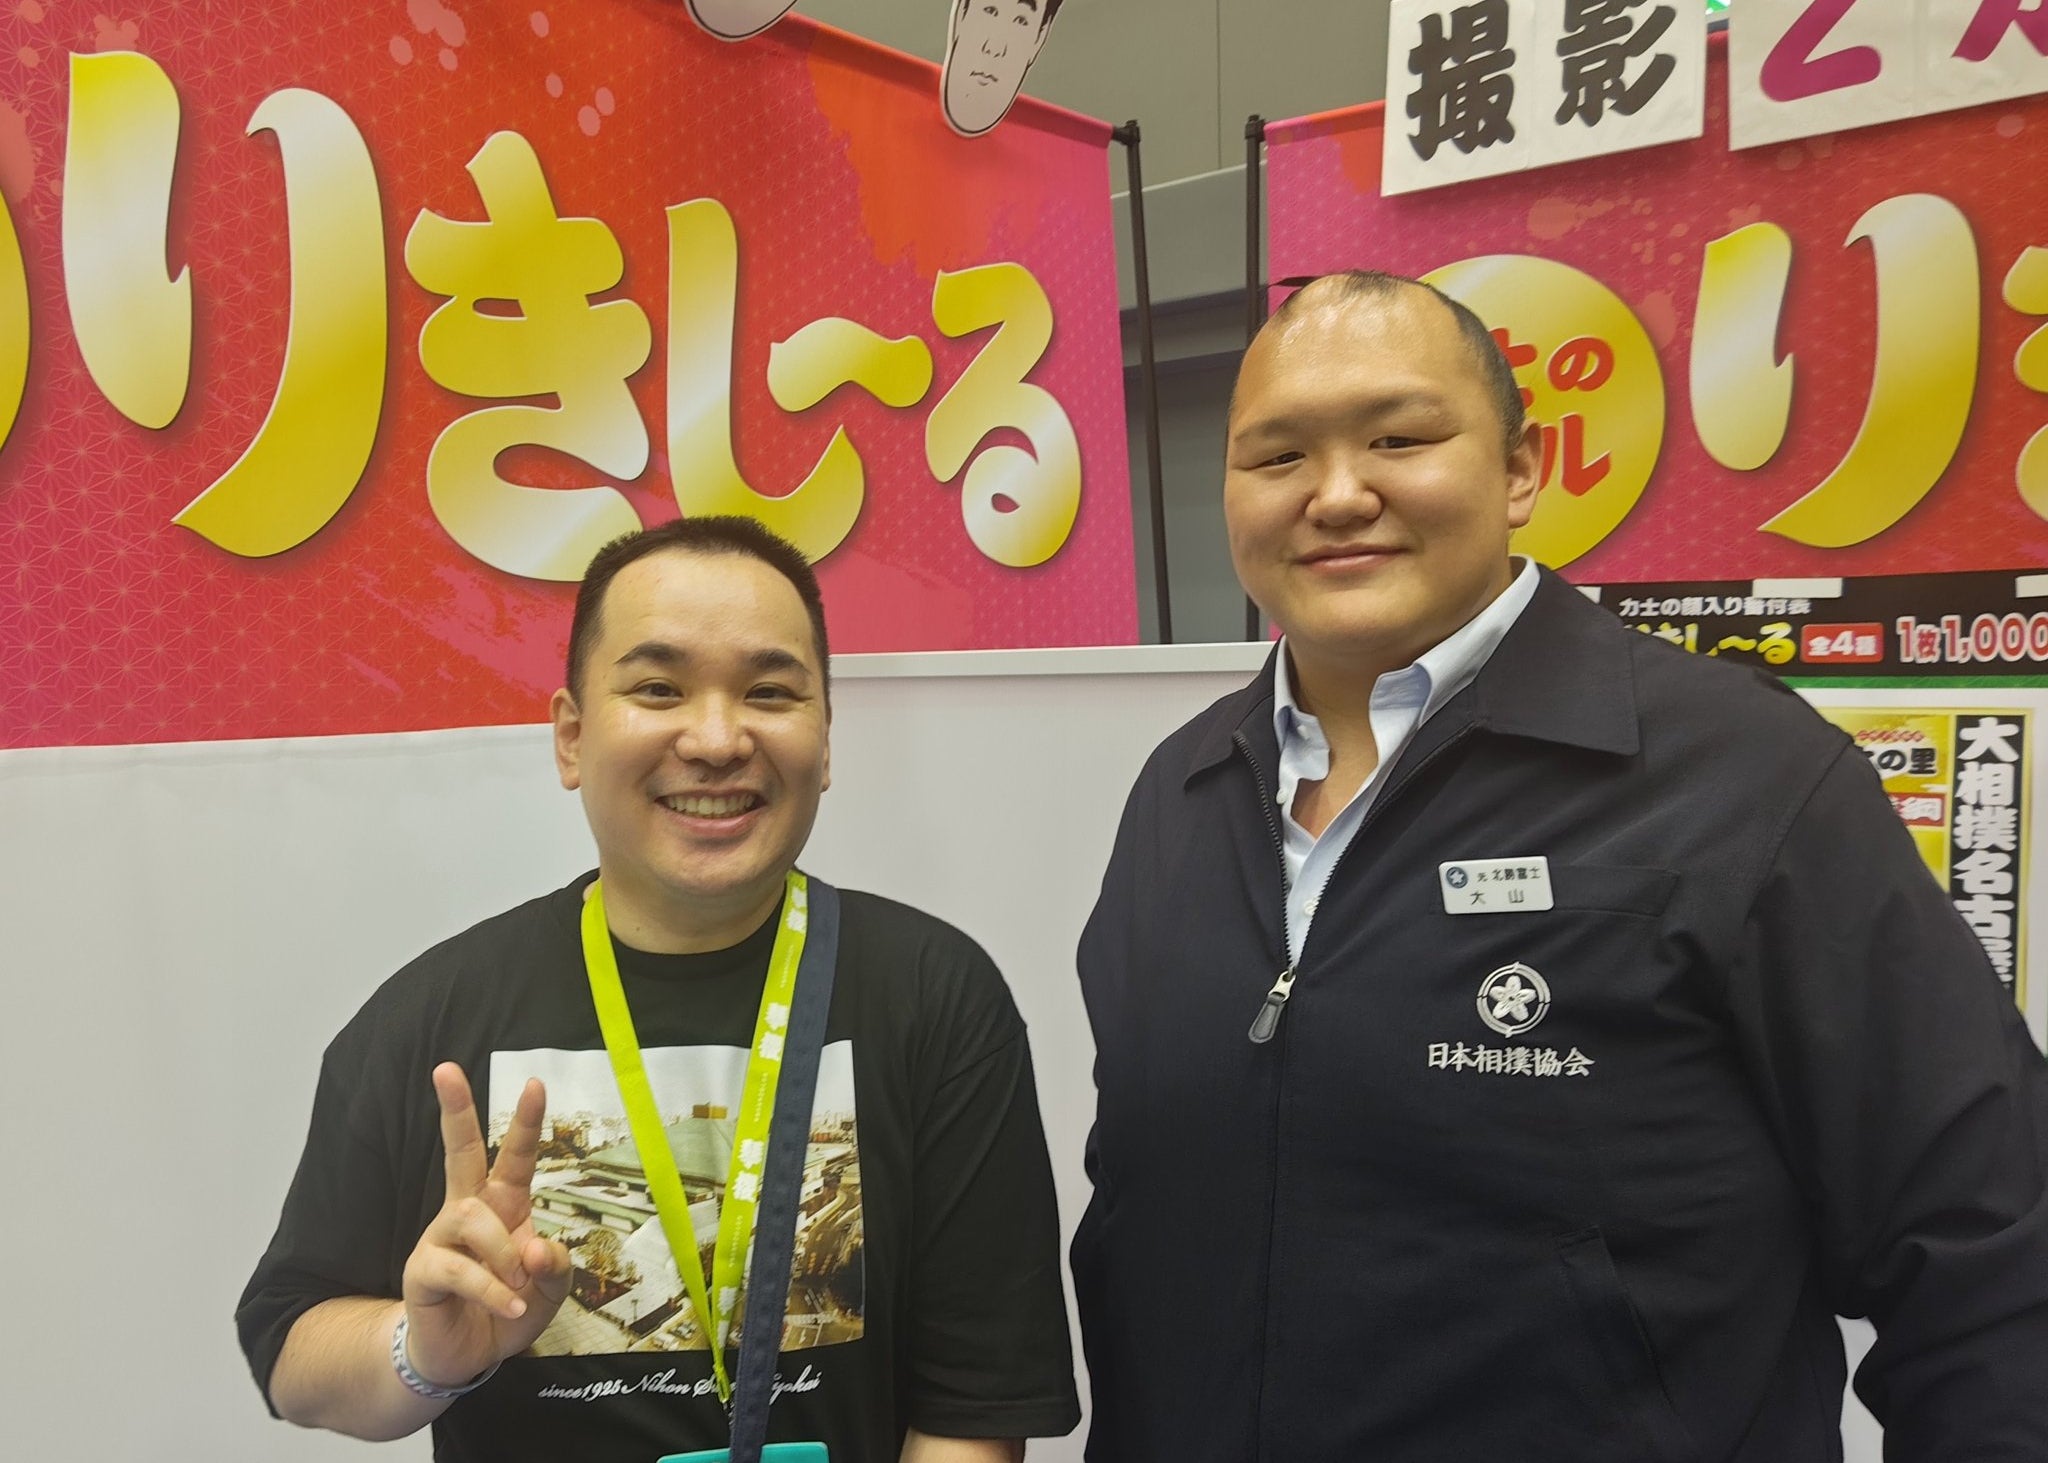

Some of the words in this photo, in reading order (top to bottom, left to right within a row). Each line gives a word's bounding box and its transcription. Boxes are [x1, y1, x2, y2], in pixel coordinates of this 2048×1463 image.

[1406, 0, 1677, 160] 撮影
[1689, 193, 2048, 548] り
[1863, 747, 1937, 775] の里
[1428, 1041, 1595, 1077] 日本相撲協会
[768, 1364, 823, 1406] yokai
